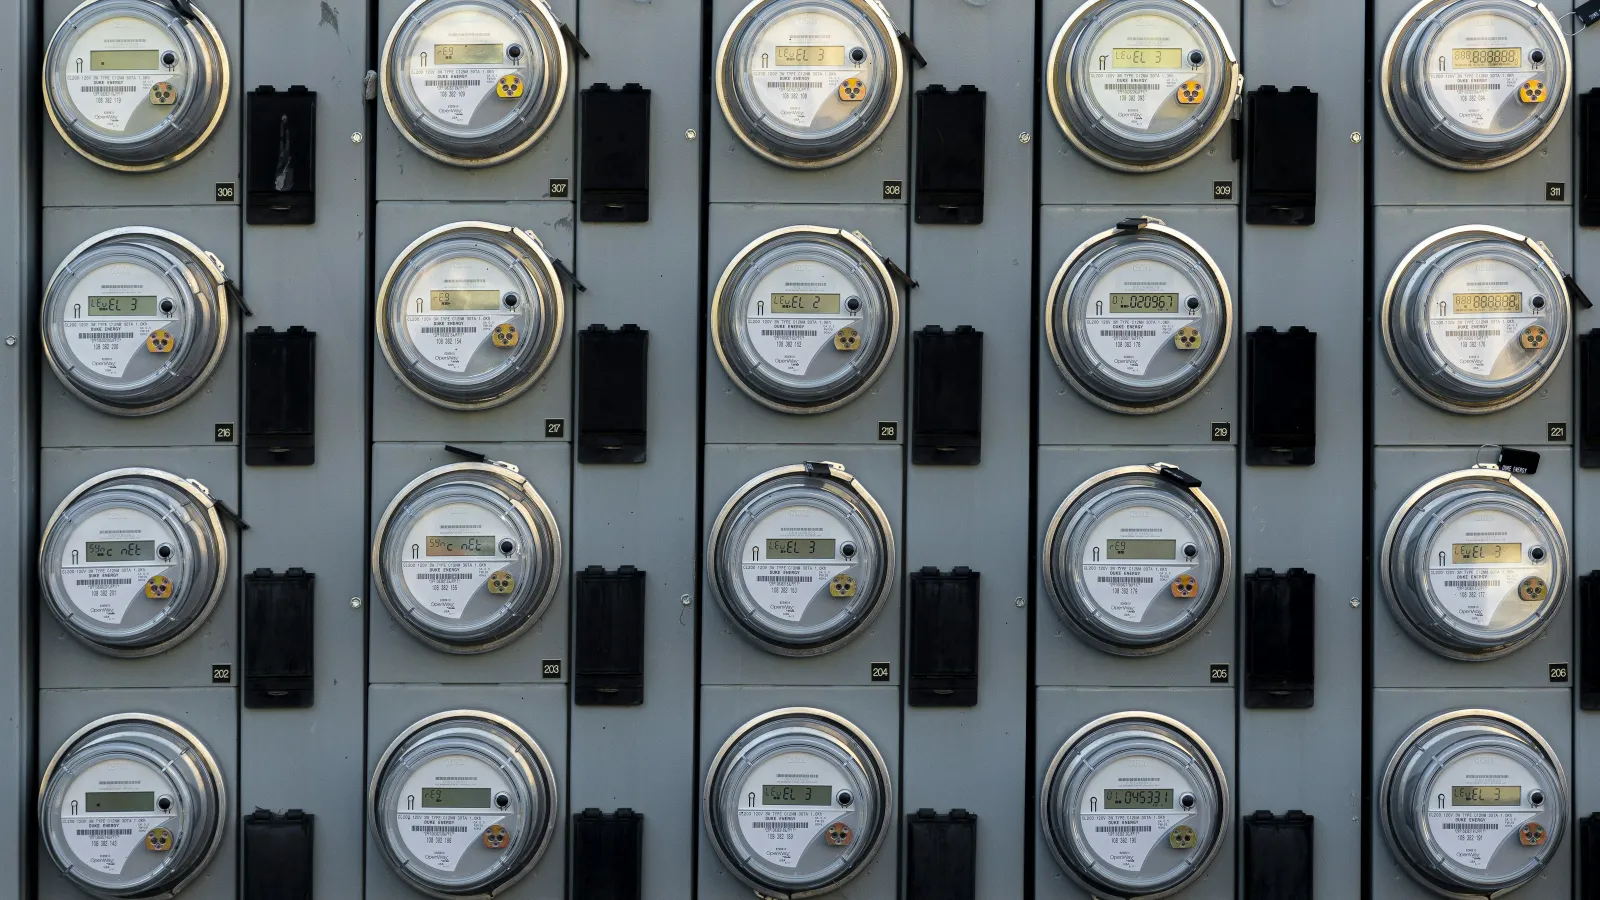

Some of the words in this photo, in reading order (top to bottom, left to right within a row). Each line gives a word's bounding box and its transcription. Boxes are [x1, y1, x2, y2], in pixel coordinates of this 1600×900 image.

[818, 48, 825, 61] 3
[1155, 51, 1161, 63] 3
[217, 188, 232, 197] 306
[551, 184, 566, 193] 307
[885, 186, 900, 195] 308
[1215, 186, 1230, 195] 309
[1550, 187, 1560, 196] 311
[131, 298, 138, 311] 3
[813, 296, 820, 309] 2
[1112, 296, 1124, 305] 01
[1130, 296, 1173, 308] 020967
[218, 428, 231, 437] 216
[548, 424, 561, 432] 217
[881, 427, 894, 436] 218
[1214, 428, 1227, 437] 219
[1551, 428, 1563, 437] 221
[1502, 464, 1512, 472] DUKE
[809, 541, 816, 554] 3
[1495, 546, 1501, 558] 3
[214, 669, 229, 678] 202
[544, 665, 559, 674] 203
[873, 668, 888, 676] 204
[1212, 669, 1227, 678] 205
[1551, 668, 1566, 677] 206
[805, 788, 812, 800] 3
[1107, 791, 1118, 801] 01
[1124, 791, 1168, 804] 045331
[1494, 788, 1501, 801] 3
